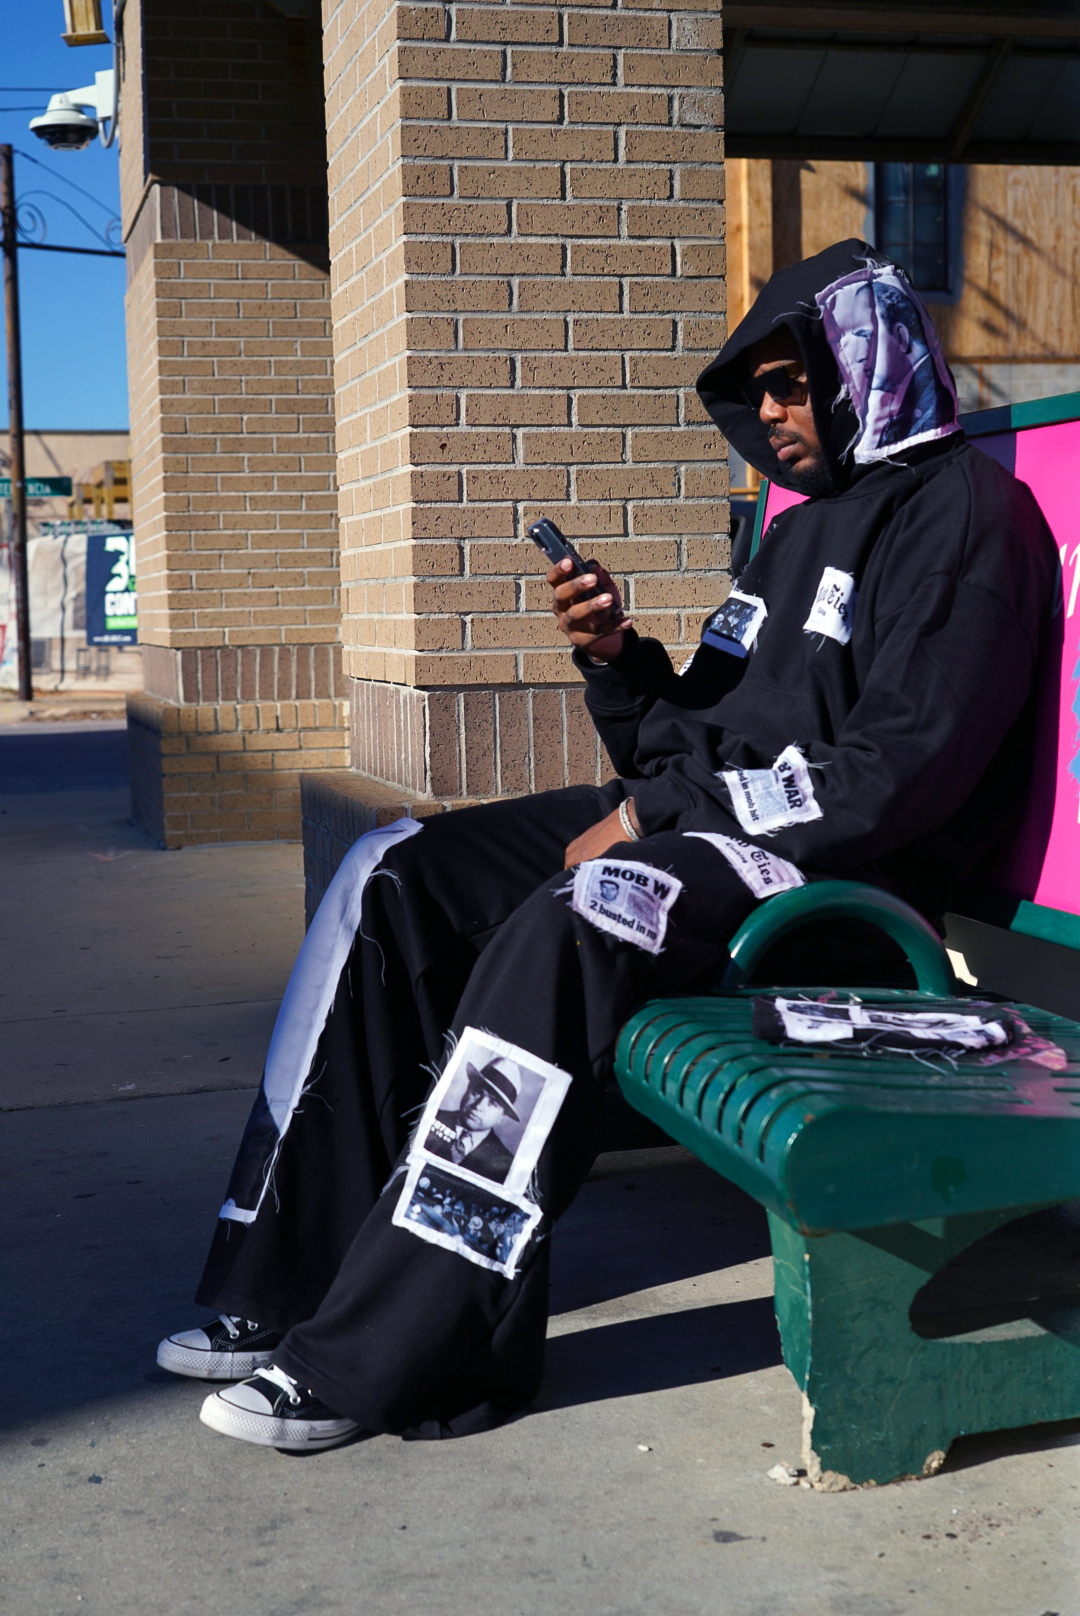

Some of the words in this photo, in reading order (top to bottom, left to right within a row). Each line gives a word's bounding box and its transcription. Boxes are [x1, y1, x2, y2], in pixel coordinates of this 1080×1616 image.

[741, 781, 750, 791] in
[781, 773, 803, 810] WAR
[744, 790, 756, 808] mob
[750, 808, 760, 822] hit
[601, 866, 650, 888] MOB
[750, 849, 773, 885] Ties
[589, 899, 598, 911] 2
[598, 903, 636, 929] busted
[635, 920, 646, 935] in
